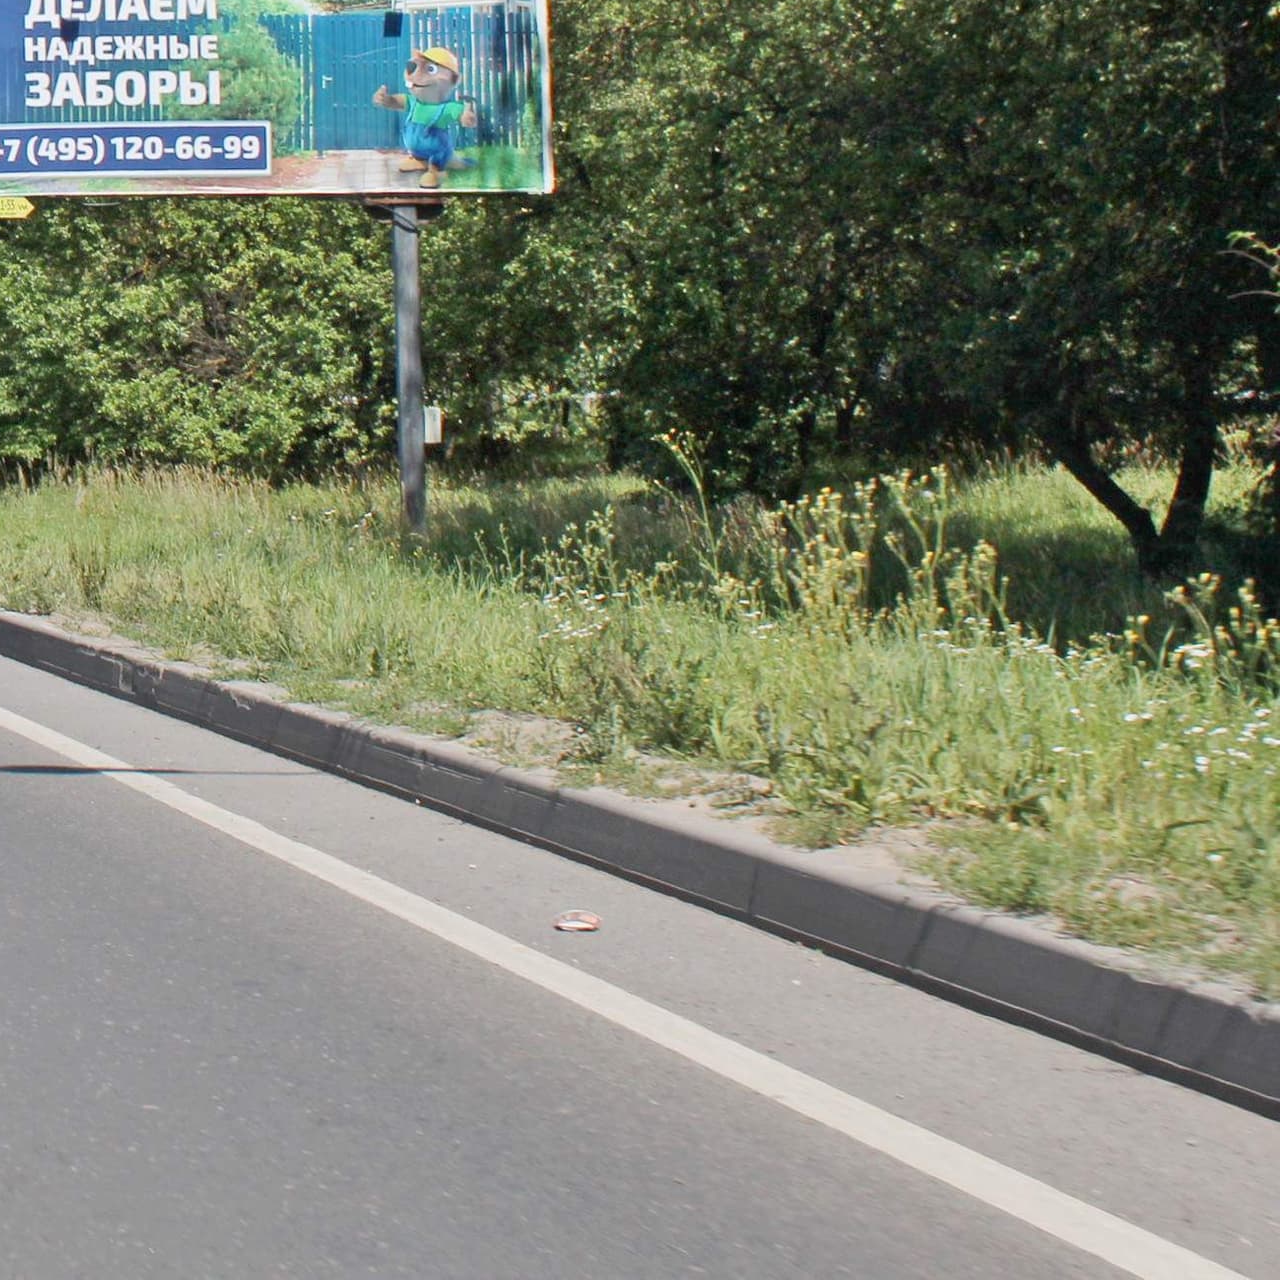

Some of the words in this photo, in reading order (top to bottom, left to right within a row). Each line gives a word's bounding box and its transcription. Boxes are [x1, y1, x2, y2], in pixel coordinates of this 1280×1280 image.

[24, 35, 220, 66] НАДЕЖНЫЕ
[24, 70, 221, 108] ЗАБОРЫ
[26, 134, 105, 166] (495)
[110, 135, 261, 161] 120-66-99
